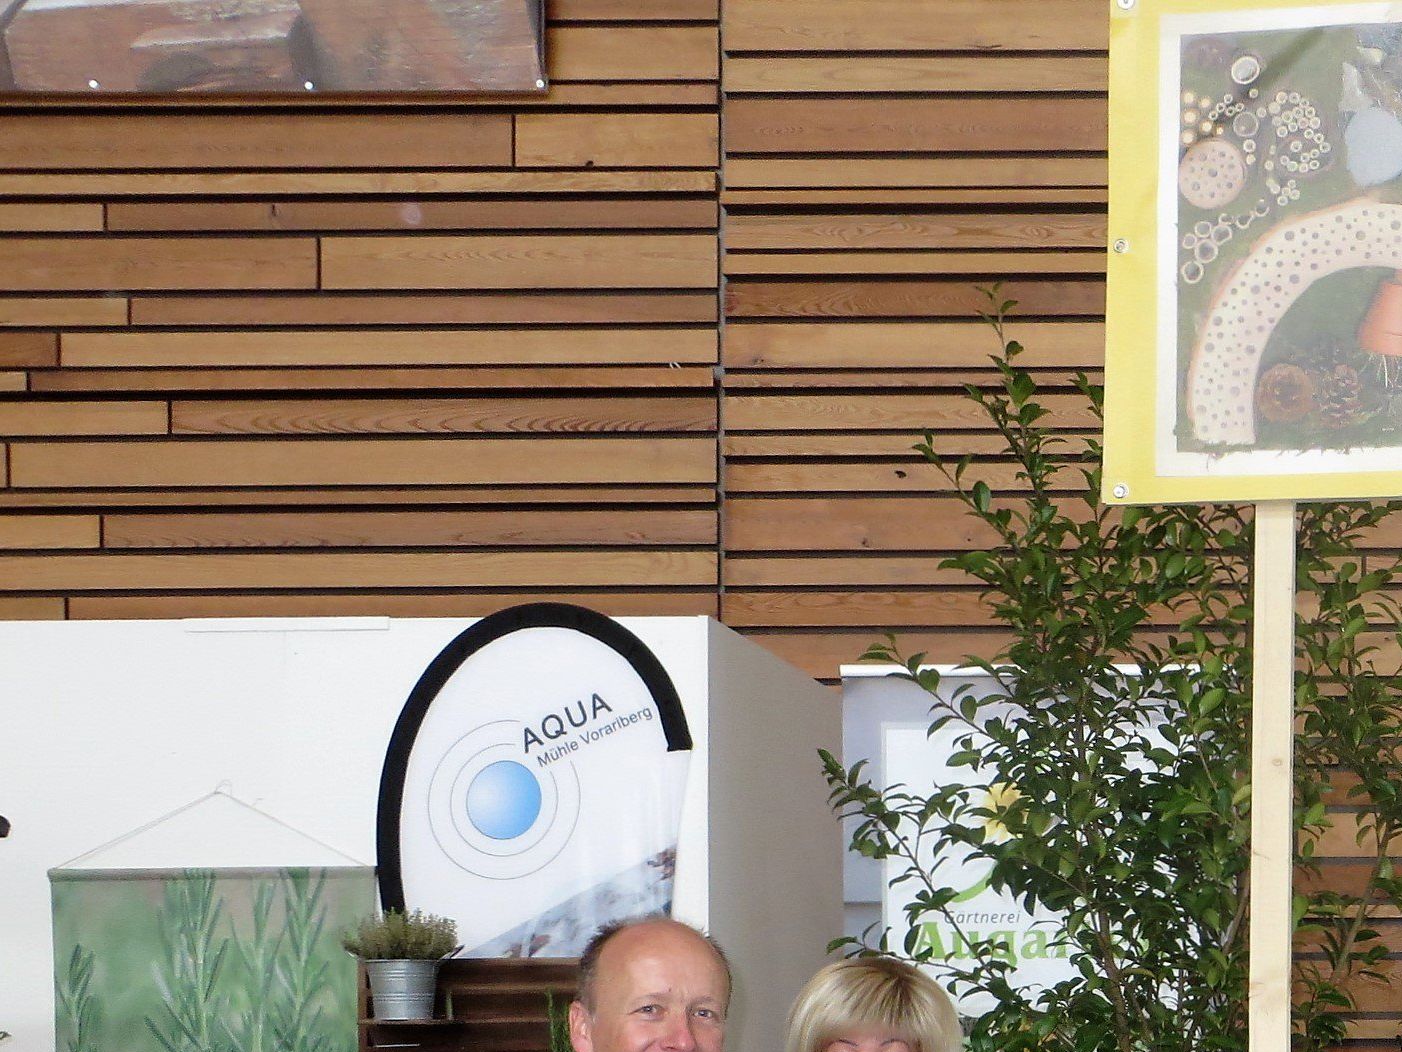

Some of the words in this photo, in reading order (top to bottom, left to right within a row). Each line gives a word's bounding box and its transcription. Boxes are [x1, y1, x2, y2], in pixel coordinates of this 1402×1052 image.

[522, 692, 613, 754] AQUA
[536, 740, 580, 768] Mühle
[579, 707, 653, 745] Vorarlberg
